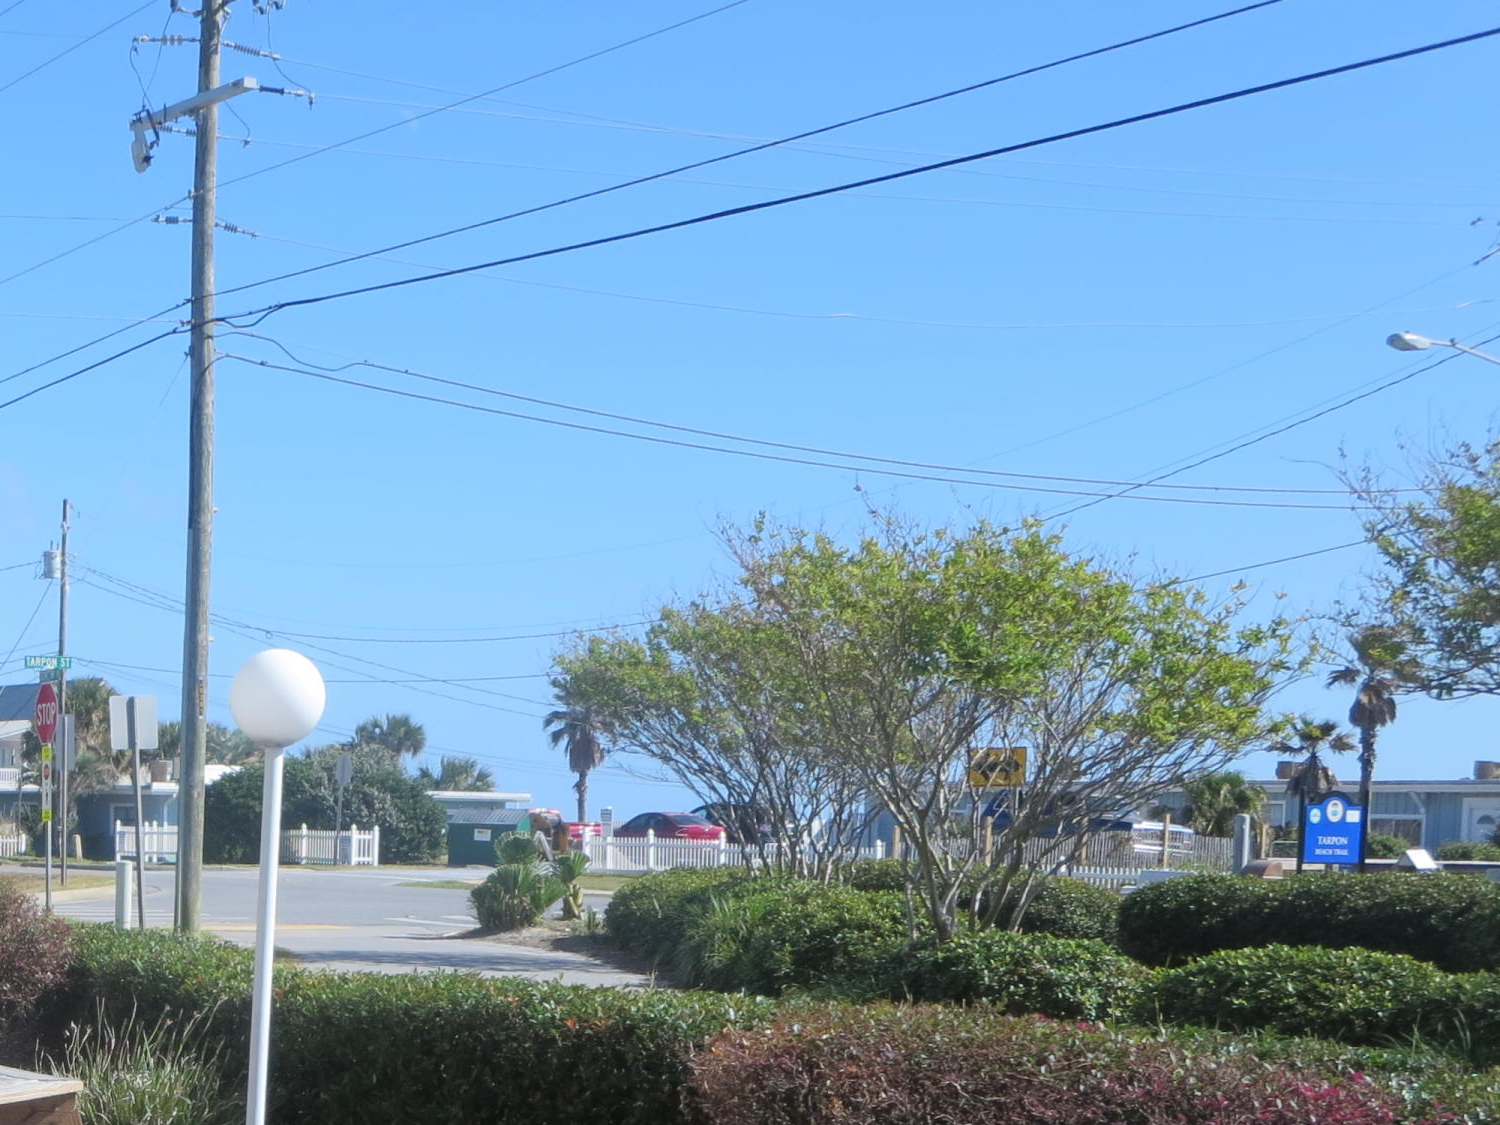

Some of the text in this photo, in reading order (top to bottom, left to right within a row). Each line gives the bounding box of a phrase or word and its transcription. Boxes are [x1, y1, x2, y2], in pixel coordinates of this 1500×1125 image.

[26, 657, 70, 668] TARPON ST
[37, 703, 56, 726] STOP
[1317, 836, 1349, 845] TARPON
